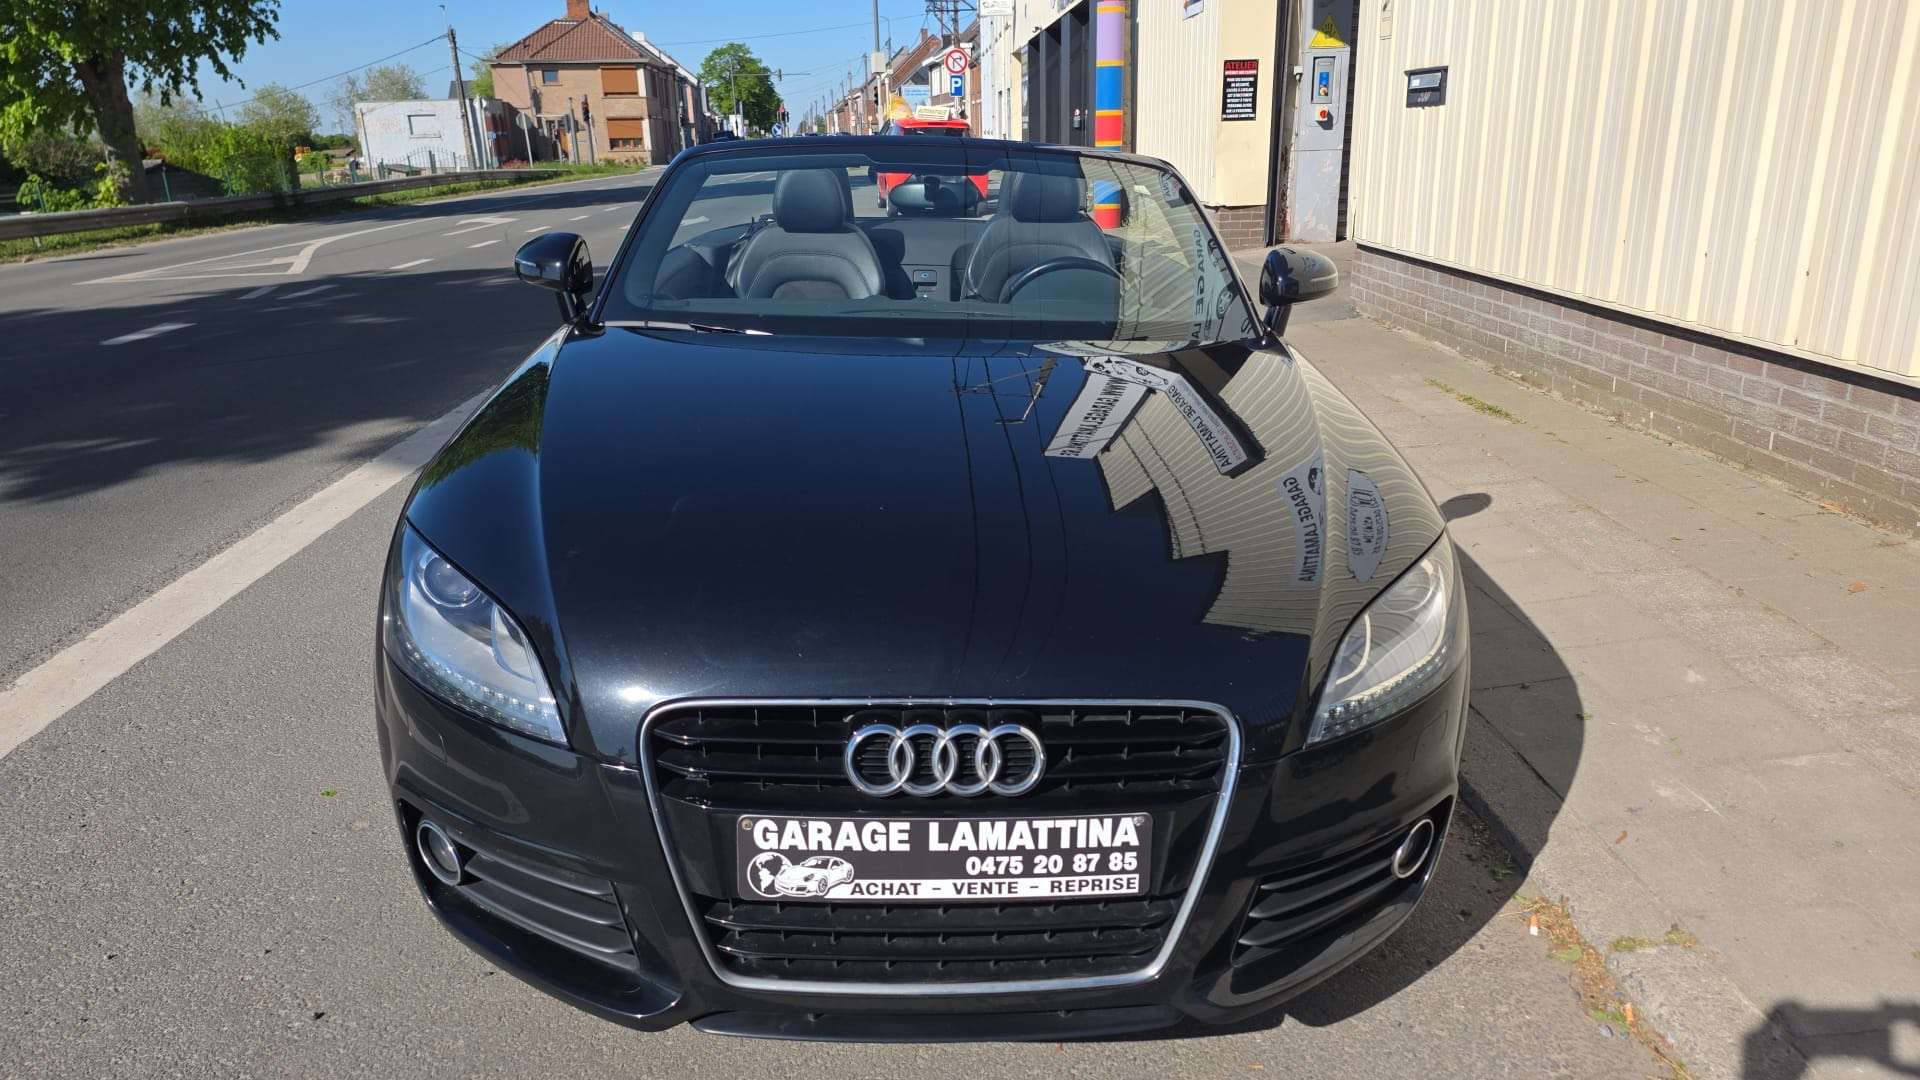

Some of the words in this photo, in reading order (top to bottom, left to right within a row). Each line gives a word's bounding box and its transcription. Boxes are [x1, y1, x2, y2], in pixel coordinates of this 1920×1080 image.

[951, 77, 962, 94] P
[753, 818, 910, 851] GARAGE
[928, 816, 1139, 852] LAMATTINA
[966, 856, 1024, 875] 0475
[1033, 855, 1063, 874] 20
[1072, 854, 1099, 873] 87
[1109, 852, 1138, 872] 85
[850, 881, 921, 896] ACHAT
[952, 880, 1019, 895] VENTE
[1050, 876, 1138, 893] REPRISE
